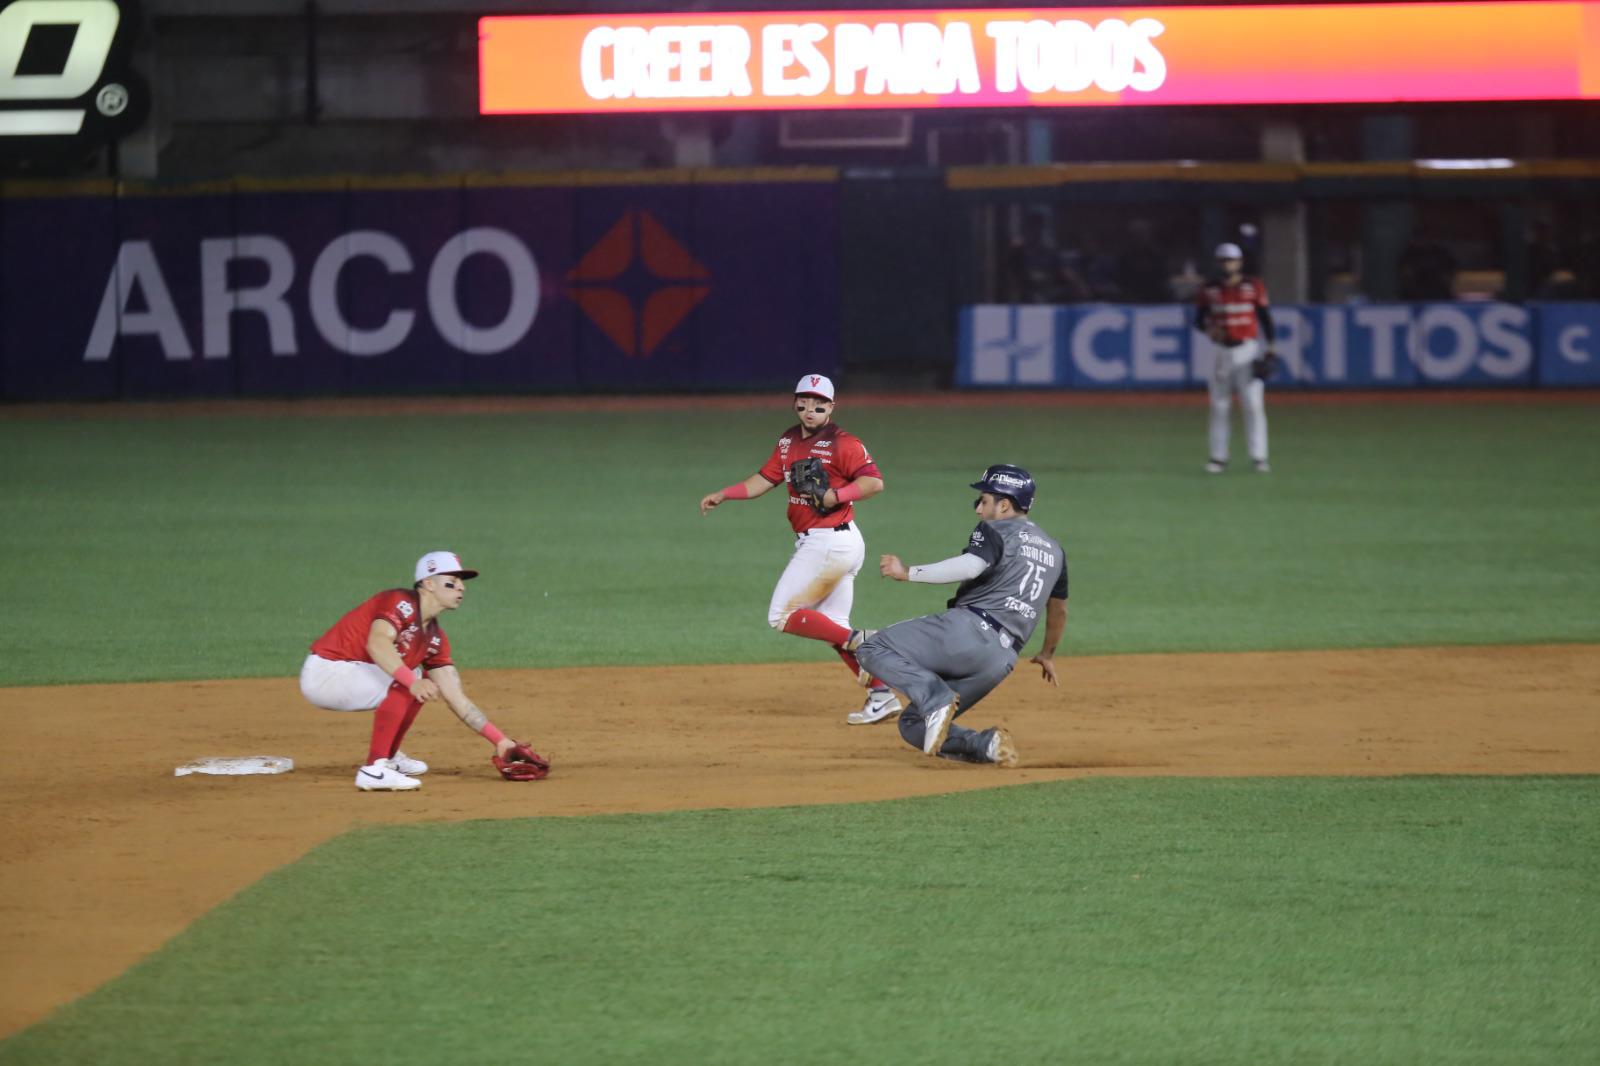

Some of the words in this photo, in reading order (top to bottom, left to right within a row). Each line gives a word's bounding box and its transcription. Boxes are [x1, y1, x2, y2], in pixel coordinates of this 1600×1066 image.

[580, 25, 752, 99] CREER
[762, 22, 830, 96] ES
[834, 22, 981, 95] PARA
[985, 18, 1167, 93] TODOS
[83, 226, 541, 362] ARCO
[1019, 560, 1047, 602] 75
